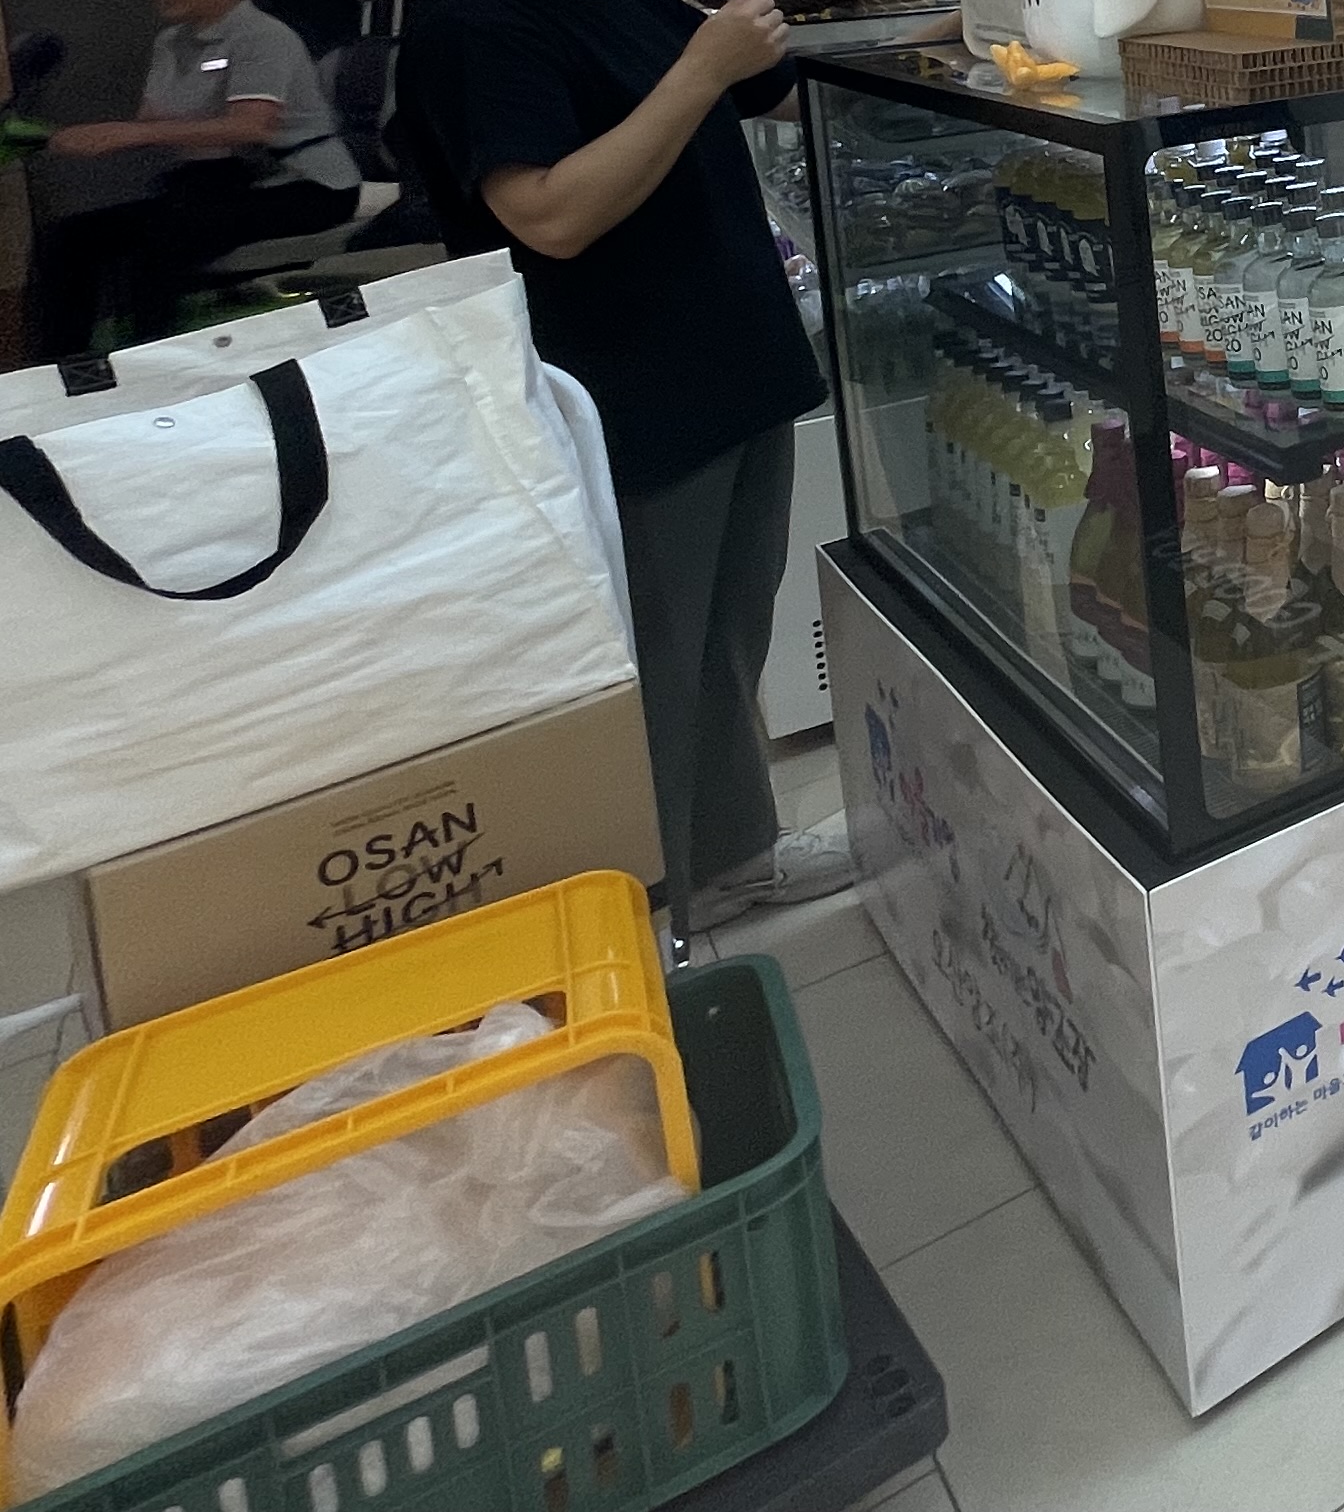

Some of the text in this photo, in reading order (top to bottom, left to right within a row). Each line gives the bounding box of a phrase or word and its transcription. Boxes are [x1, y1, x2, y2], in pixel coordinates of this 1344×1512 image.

[1205, 328, 1223, 342] 20
[317, 802, 478, 887] OSAN
[342, 846, 472, 915] LOW
